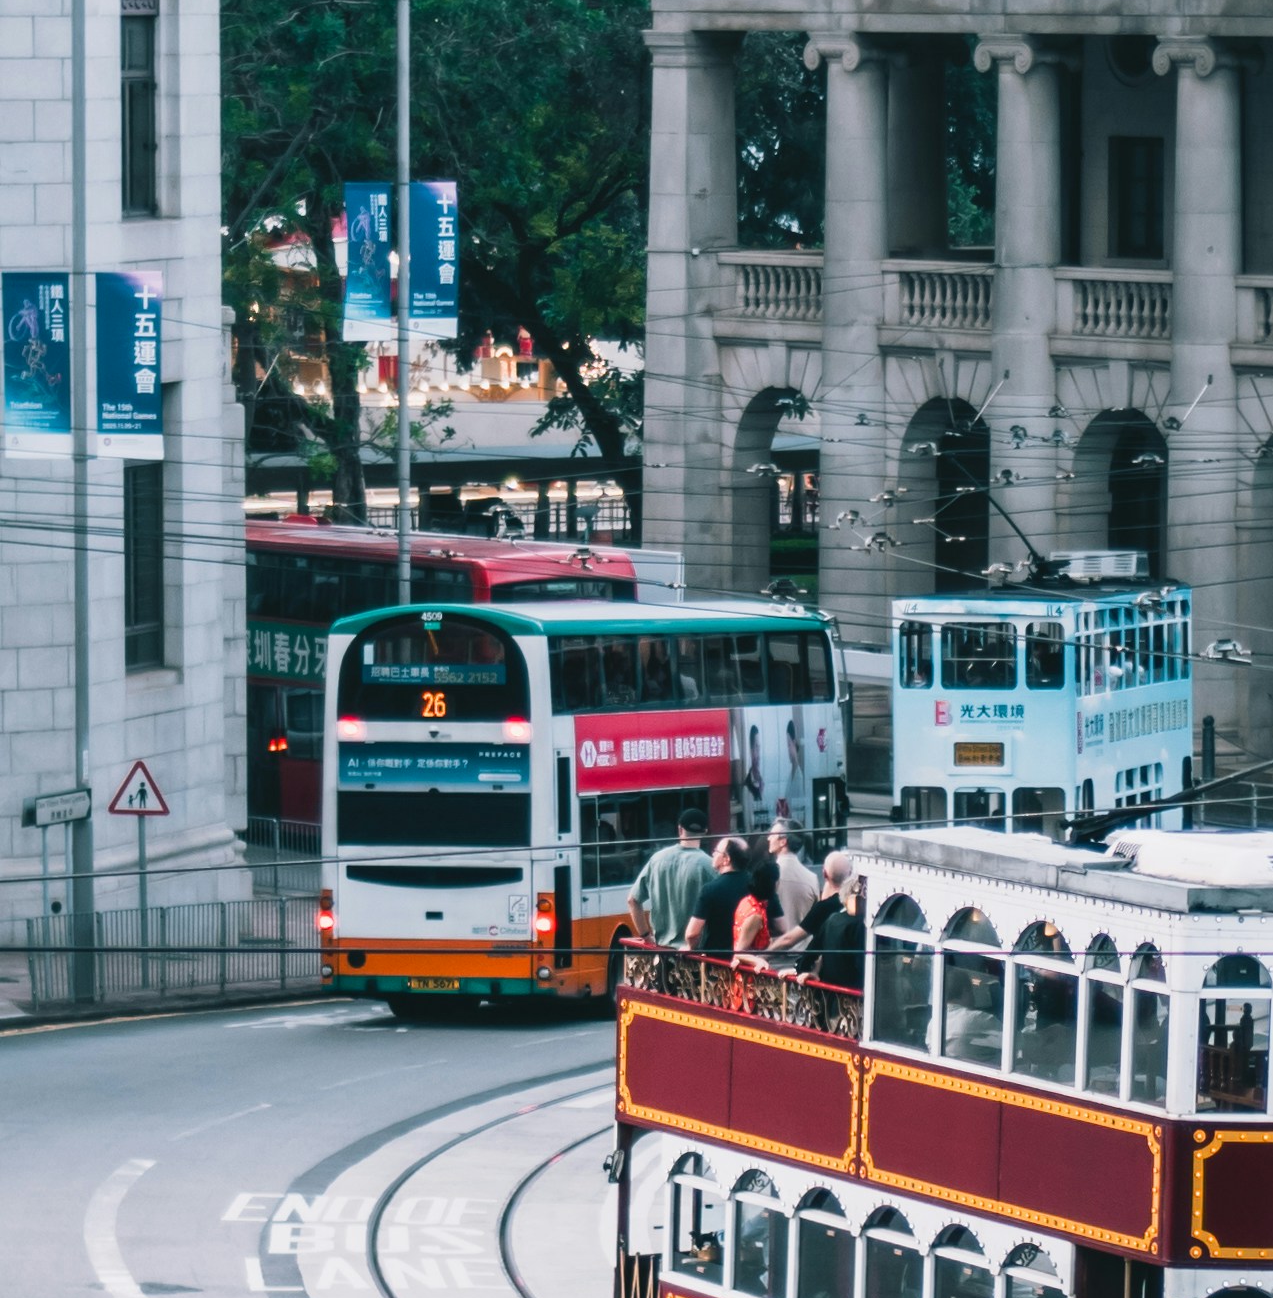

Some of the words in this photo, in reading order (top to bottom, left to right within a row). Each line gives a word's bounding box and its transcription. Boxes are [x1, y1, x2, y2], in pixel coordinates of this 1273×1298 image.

[437, 194, 455, 284] 十五運會
[134, 285, 157, 394] 十五運會
[102, 403, 116, 411] The
[102, 412, 132, 420] National
[133, 412, 157, 420] Games
[421, 612, 443, 622] 4509
[421, 690, 447, 718] 26
[960, 704, 1025, 719] 光大環境
[221, 1192, 380, 1223] END
[394, 1195, 498, 1226] OF
[267, 1223, 486, 1255] BUS
[245, 1256, 511, 1292] LANE
